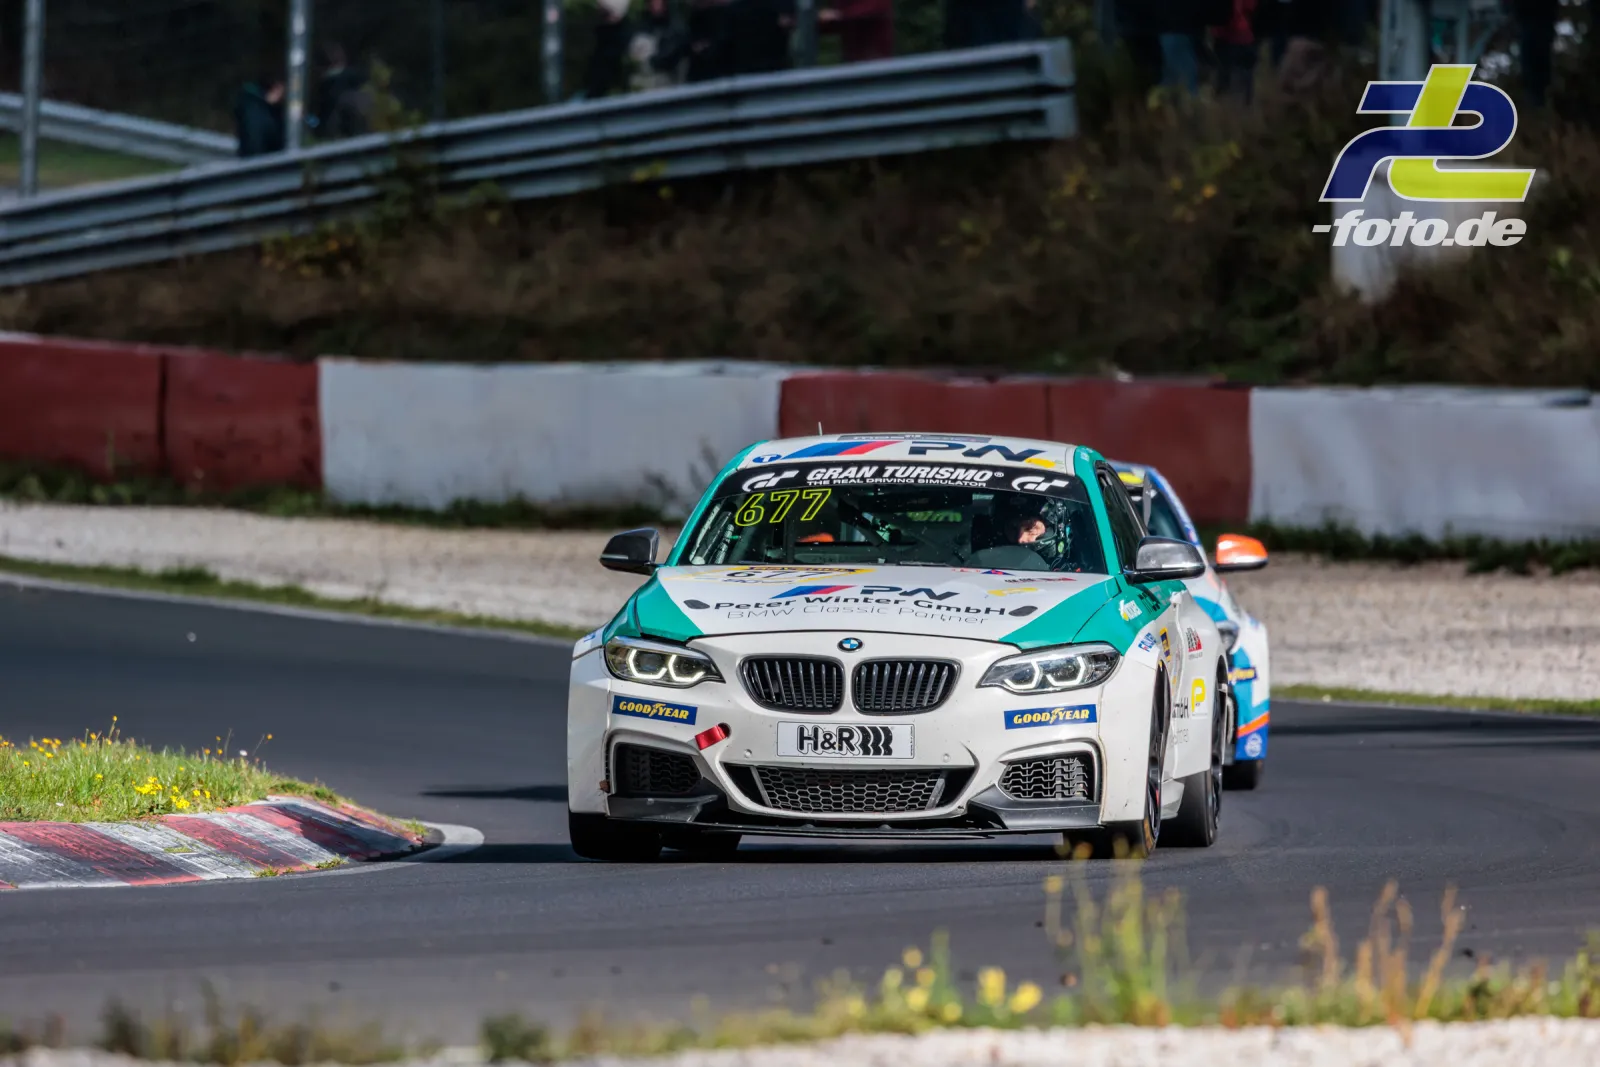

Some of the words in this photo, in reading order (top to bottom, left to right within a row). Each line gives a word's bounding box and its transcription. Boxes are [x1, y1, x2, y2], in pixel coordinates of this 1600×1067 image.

[806, 466, 879, 481] GRAN
[917, 478, 987, 488] SIMULATOR
[735, 488, 831, 527] 677
[714, 599, 797, 610] Peter
[804, 596, 906, 605] Winter
[913, 600, 1006, 616] GmbH
[727, 607, 795, 619] BMW
[803, 605, 888, 615] Classic
[898, 607, 989, 624] Partner
[619, 701, 690, 720] GOODYEAR
[1013, 707, 1090, 724] GOODYEAR
[797, 725, 860, 755] H&R
